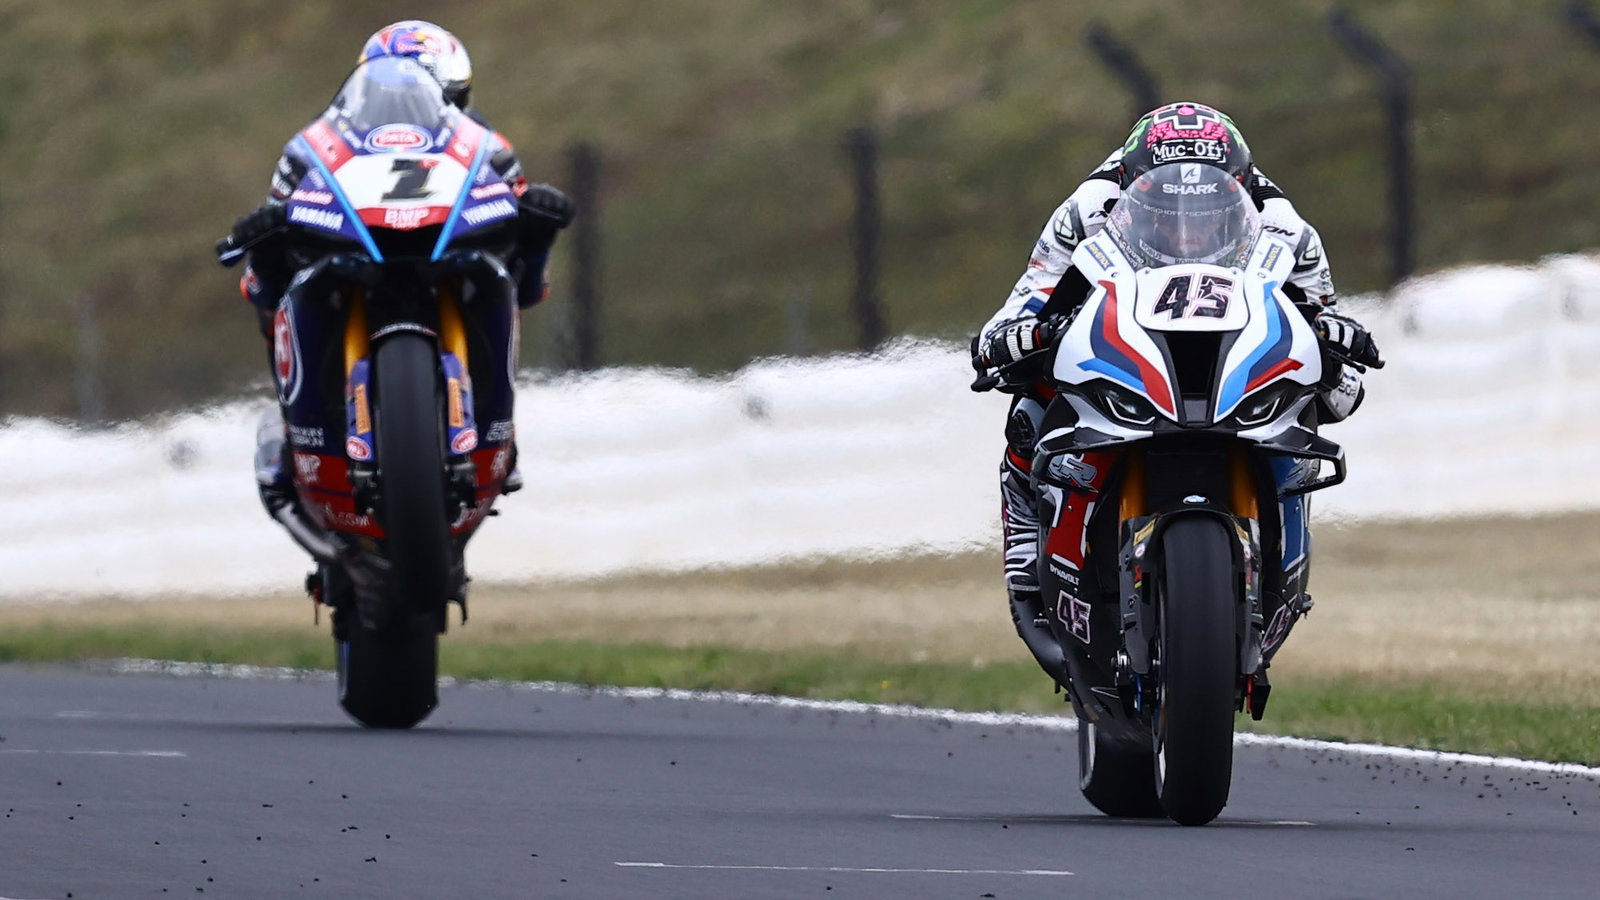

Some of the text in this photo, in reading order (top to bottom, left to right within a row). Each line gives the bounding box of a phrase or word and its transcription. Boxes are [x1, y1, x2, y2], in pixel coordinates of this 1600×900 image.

[1153, 141, 1224, 160] Muc-Off
[381, 159, 438, 201] 1
[1162, 182, 1219, 195] SHARK
[290, 205, 344, 231] YAMAHA
[461, 198, 516, 226] YAMAHA
[1151, 273, 1235, 321] 45
[1049, 563, 1080, 586] DYNAVOLT
[1057, 590, 1091, 644] 45
